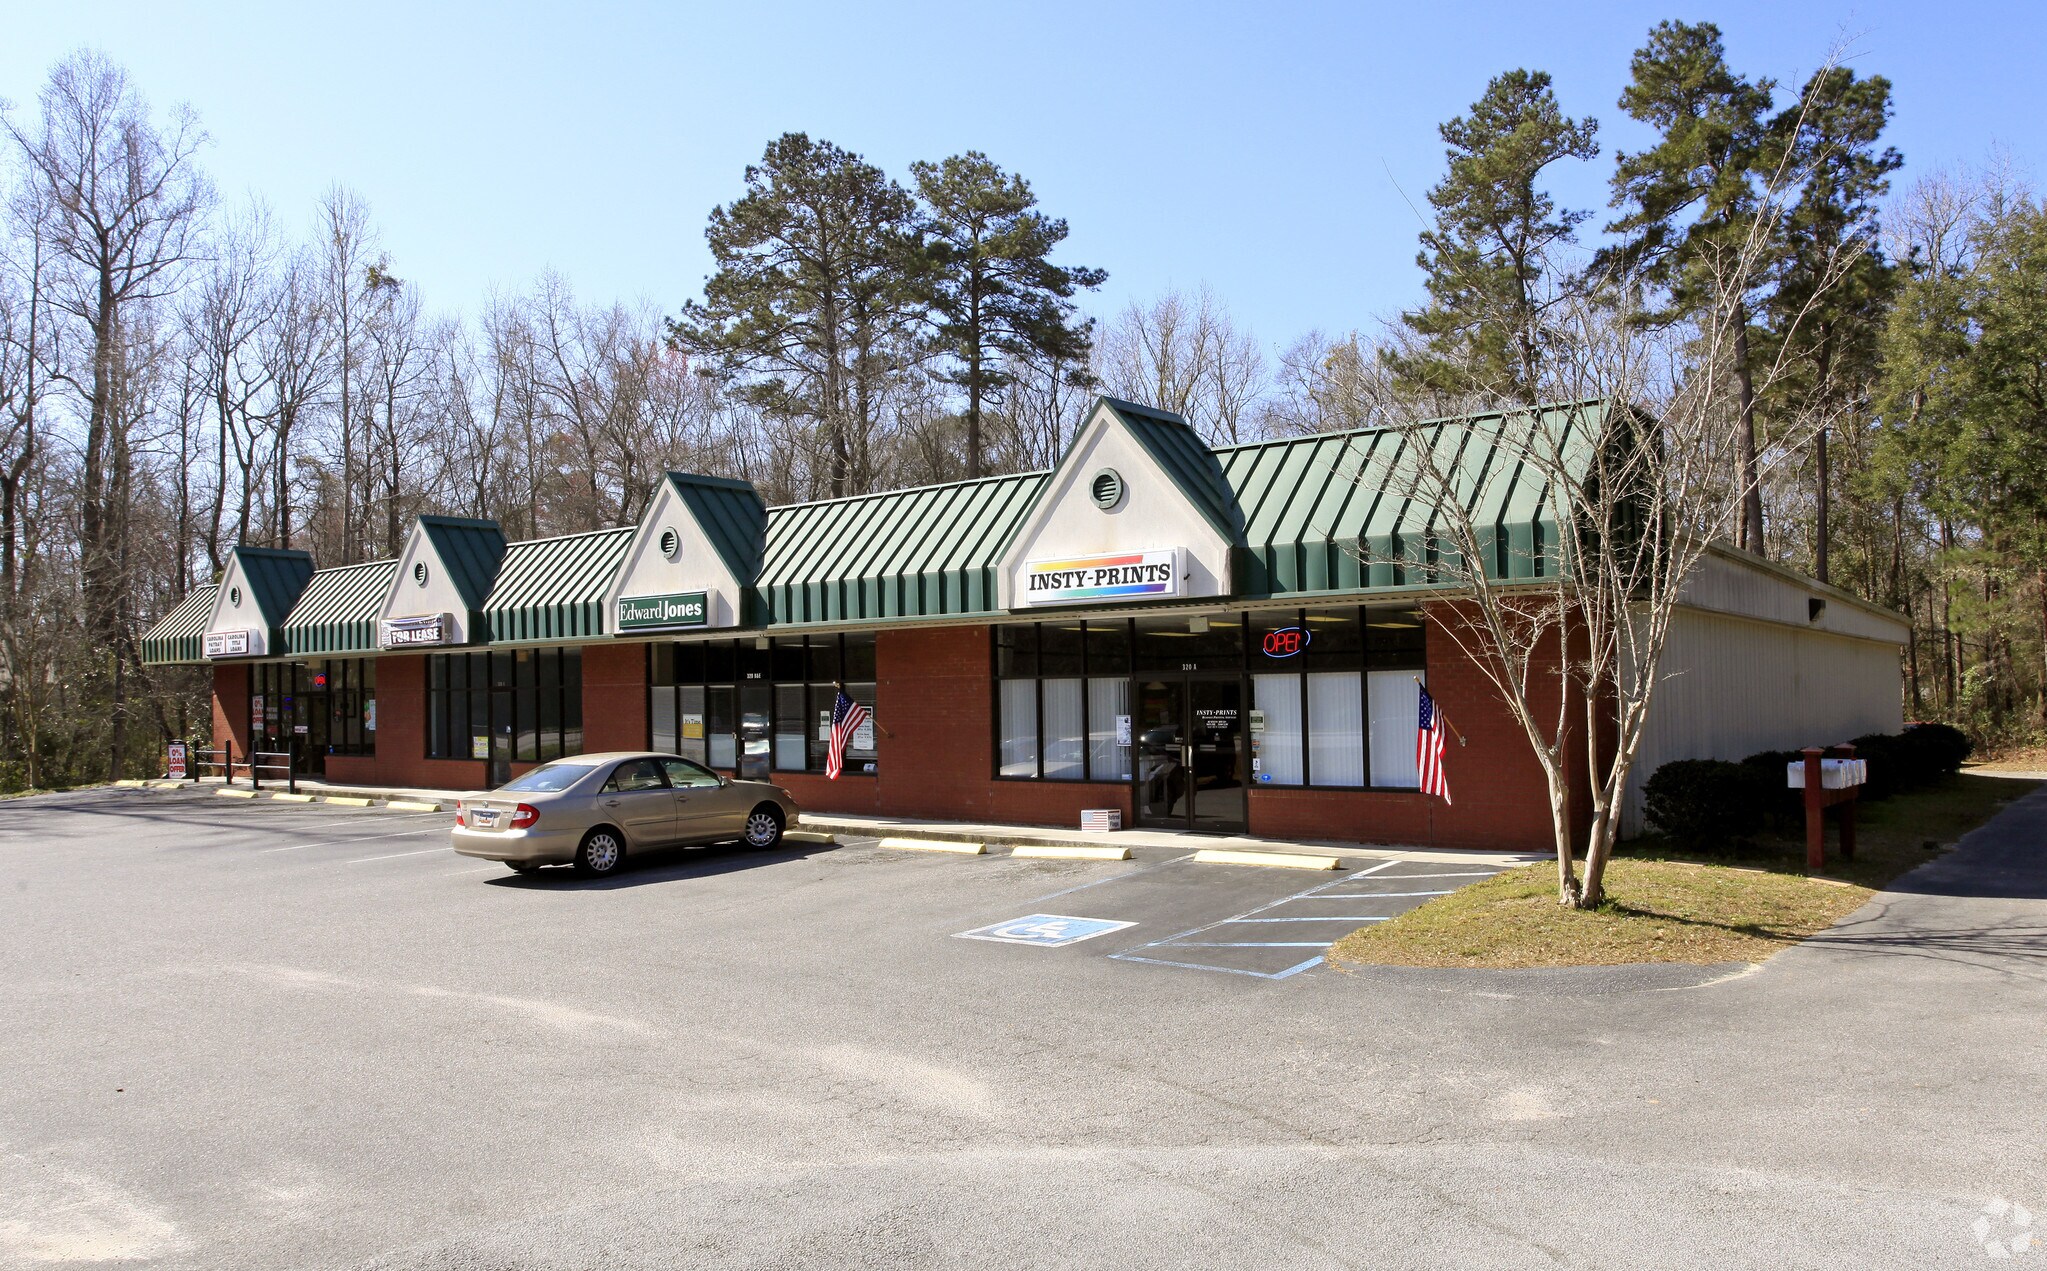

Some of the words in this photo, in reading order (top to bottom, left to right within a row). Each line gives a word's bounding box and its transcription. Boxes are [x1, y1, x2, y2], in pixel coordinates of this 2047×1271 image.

[1029, 563, 1171, 591] INSTY-PRINTS
[619, 601, 662, 620] Edward
[663, 600, 702, 620] Jones
[391, 630, 409, 644] FOR
[411, 628, 440, 642] LEASE
[1182, 663, 1192, 671] 320
[169, 757, 185, 765] LOAN
[169, 765, 185, 773] OFFER
